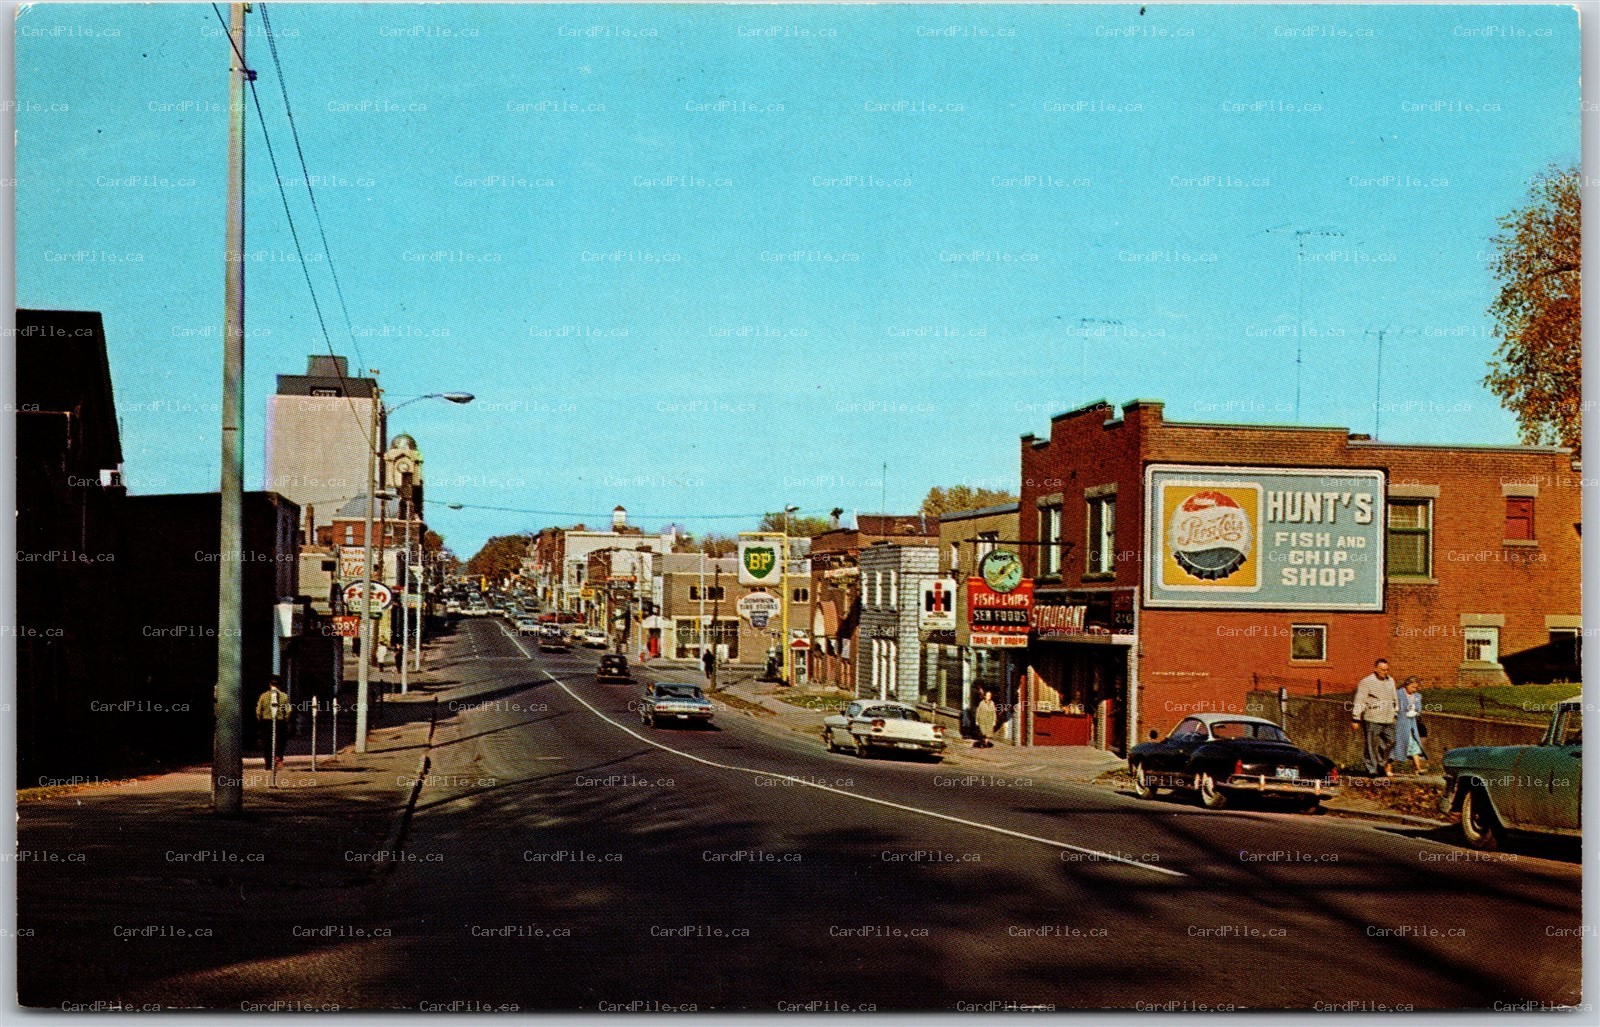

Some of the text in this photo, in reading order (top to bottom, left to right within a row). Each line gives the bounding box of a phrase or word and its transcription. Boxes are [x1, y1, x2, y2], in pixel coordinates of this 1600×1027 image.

[1267, 490, 1373, 525] HUNT'S
[1275, 532, 1366, 549] FISH AND
[749, 553, 772, 570] BP
[1288, 550, 1348, 565] CHIP
[1281, 567, 1355, 587] SHOP
[973, 593, 995, 606] FISH
[1001, 593, 1030, 607] CHIPS
[973, 609, 1027, 622] SEA FOODS
[1029, 604, 1087, 631] STAURANT
